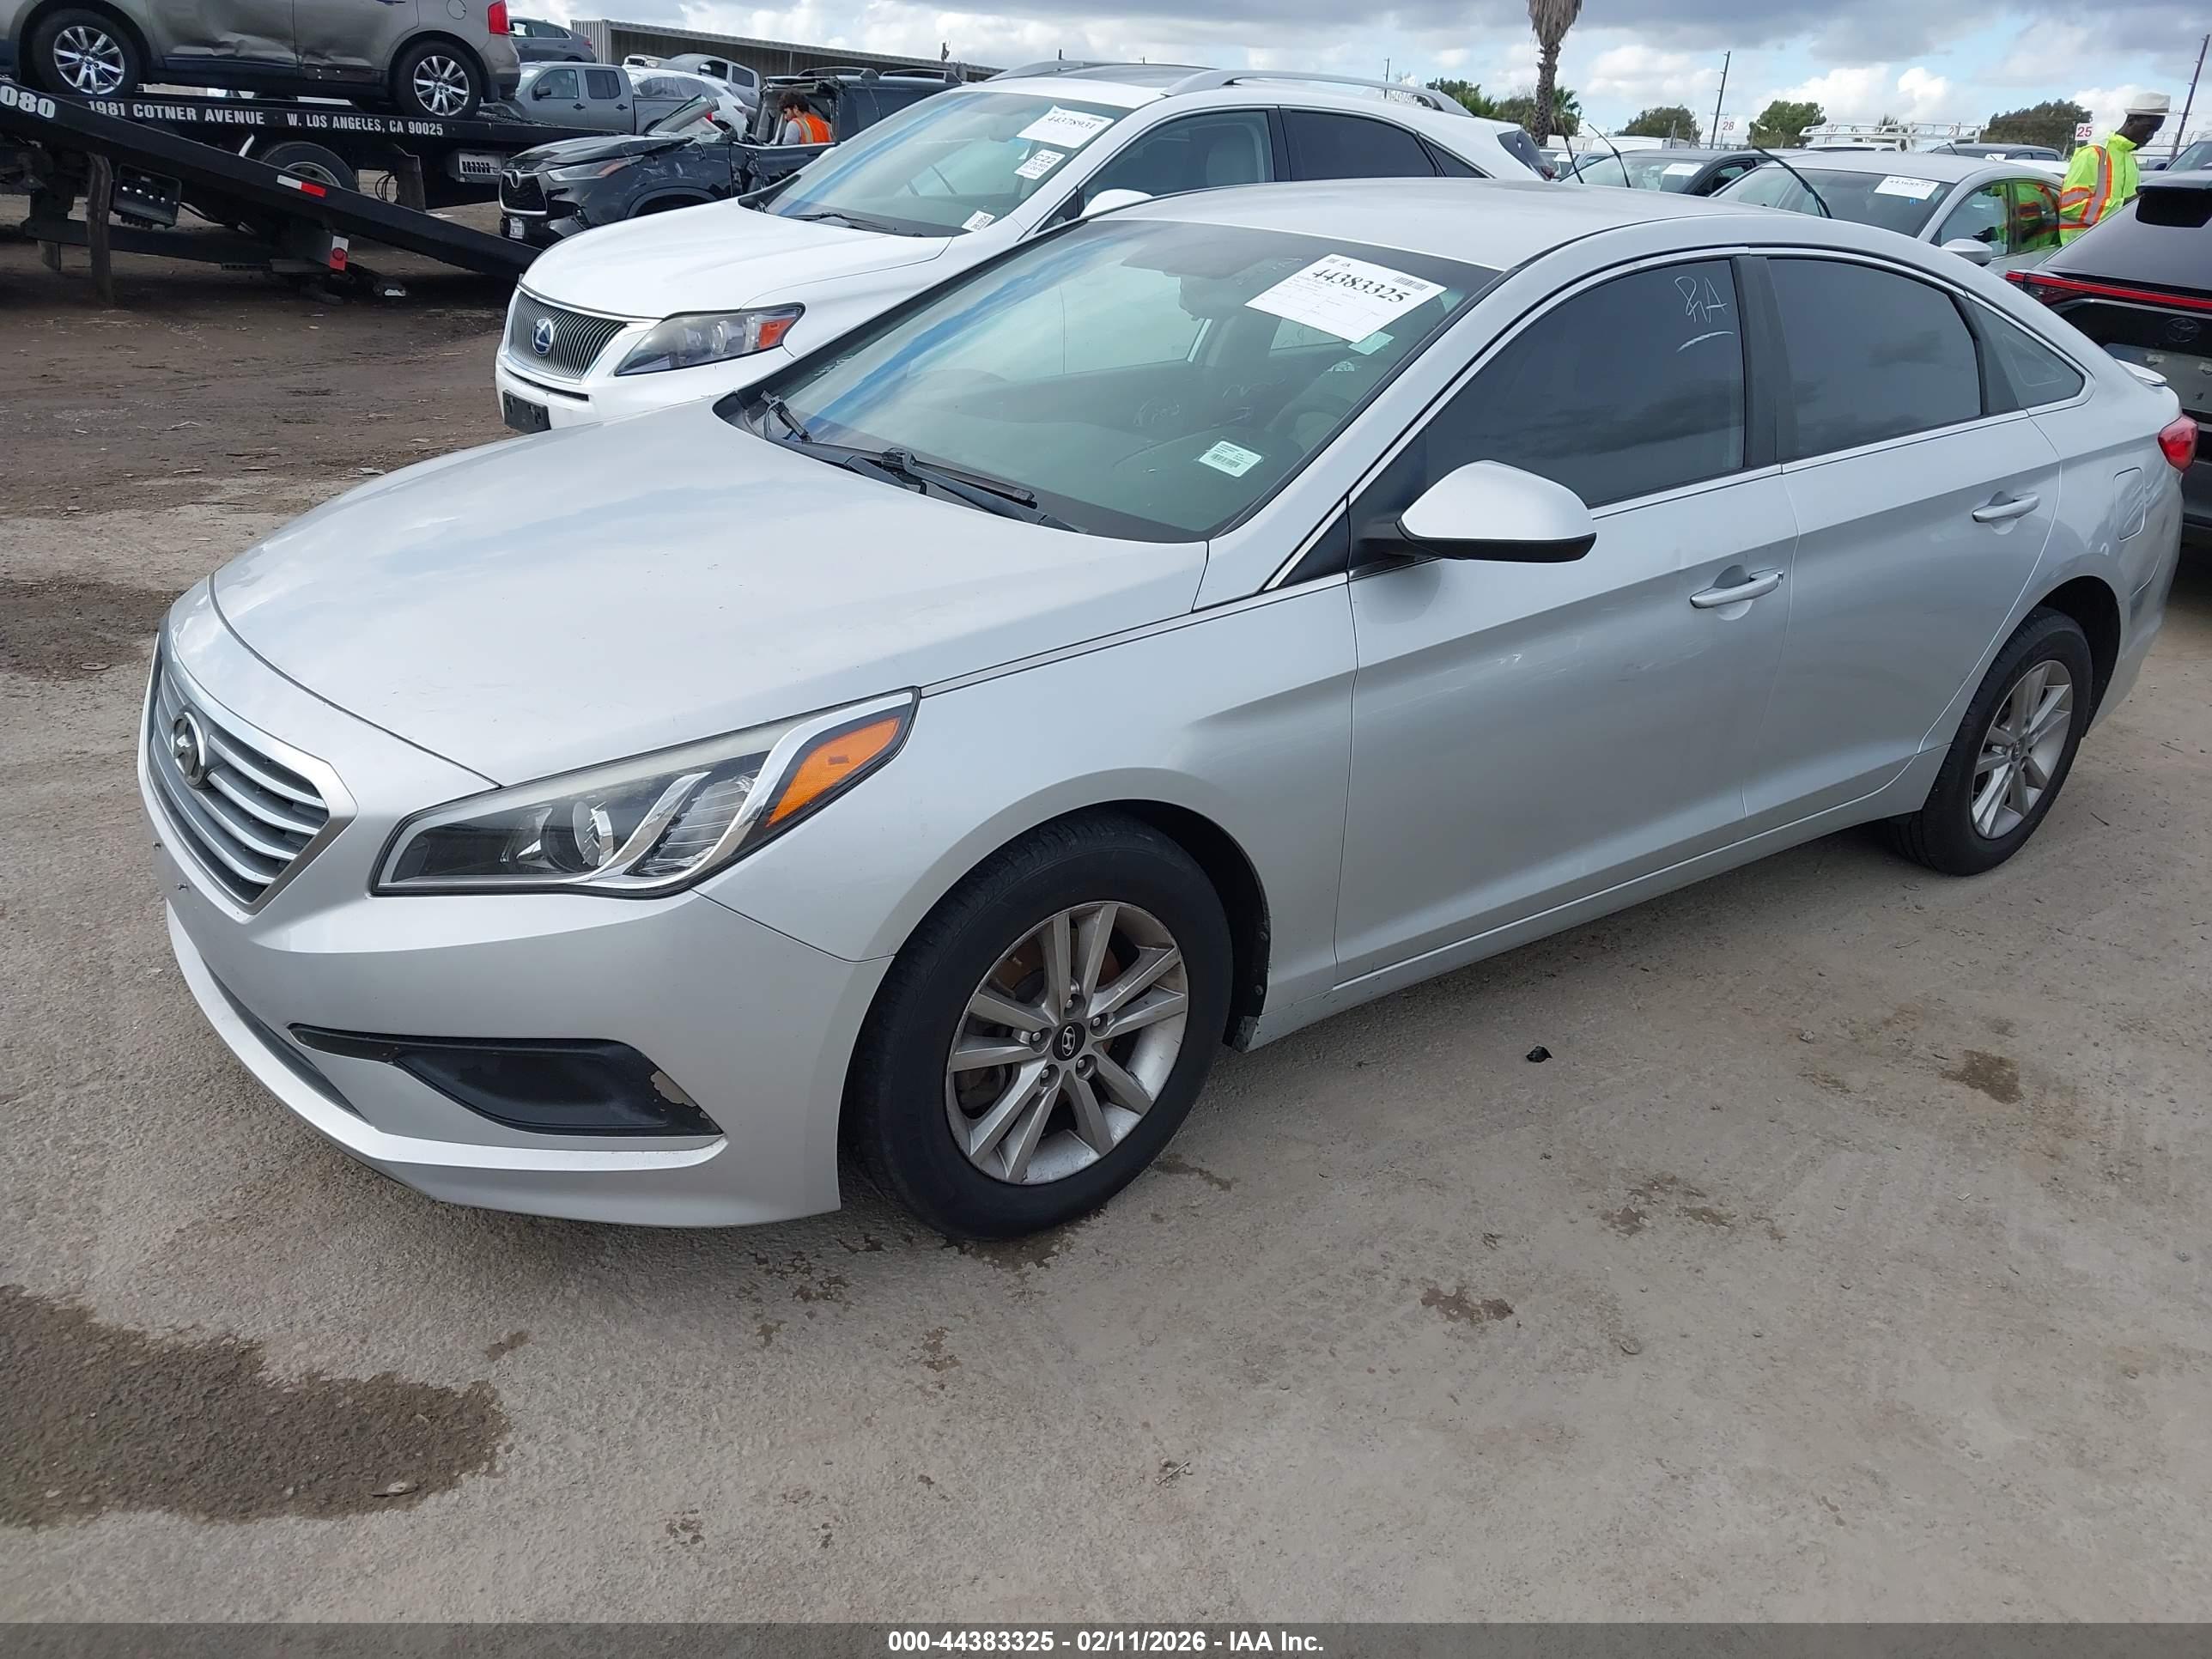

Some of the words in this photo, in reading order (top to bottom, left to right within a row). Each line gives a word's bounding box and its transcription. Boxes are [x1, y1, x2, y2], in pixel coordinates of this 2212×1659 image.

[88, 100, 126, 117] 1981
[132, 103, 198, 121] COTNER
[204, 108, 265, 125] AVENUE
[287, 112, 302, 127] W.
[307, 114, 328, 128] LOS
[332, 116, 386, 133] ANGELES,
[389, 120, 404, 133] CA
[408, 122, 443, 137] 90025
[1723, 121, 1735, 131] 28
[2076, 126, 2093, 137] 25
[1033, 154, 1058, 165] C22
[1312, 268, 1412, 303] 44383325
